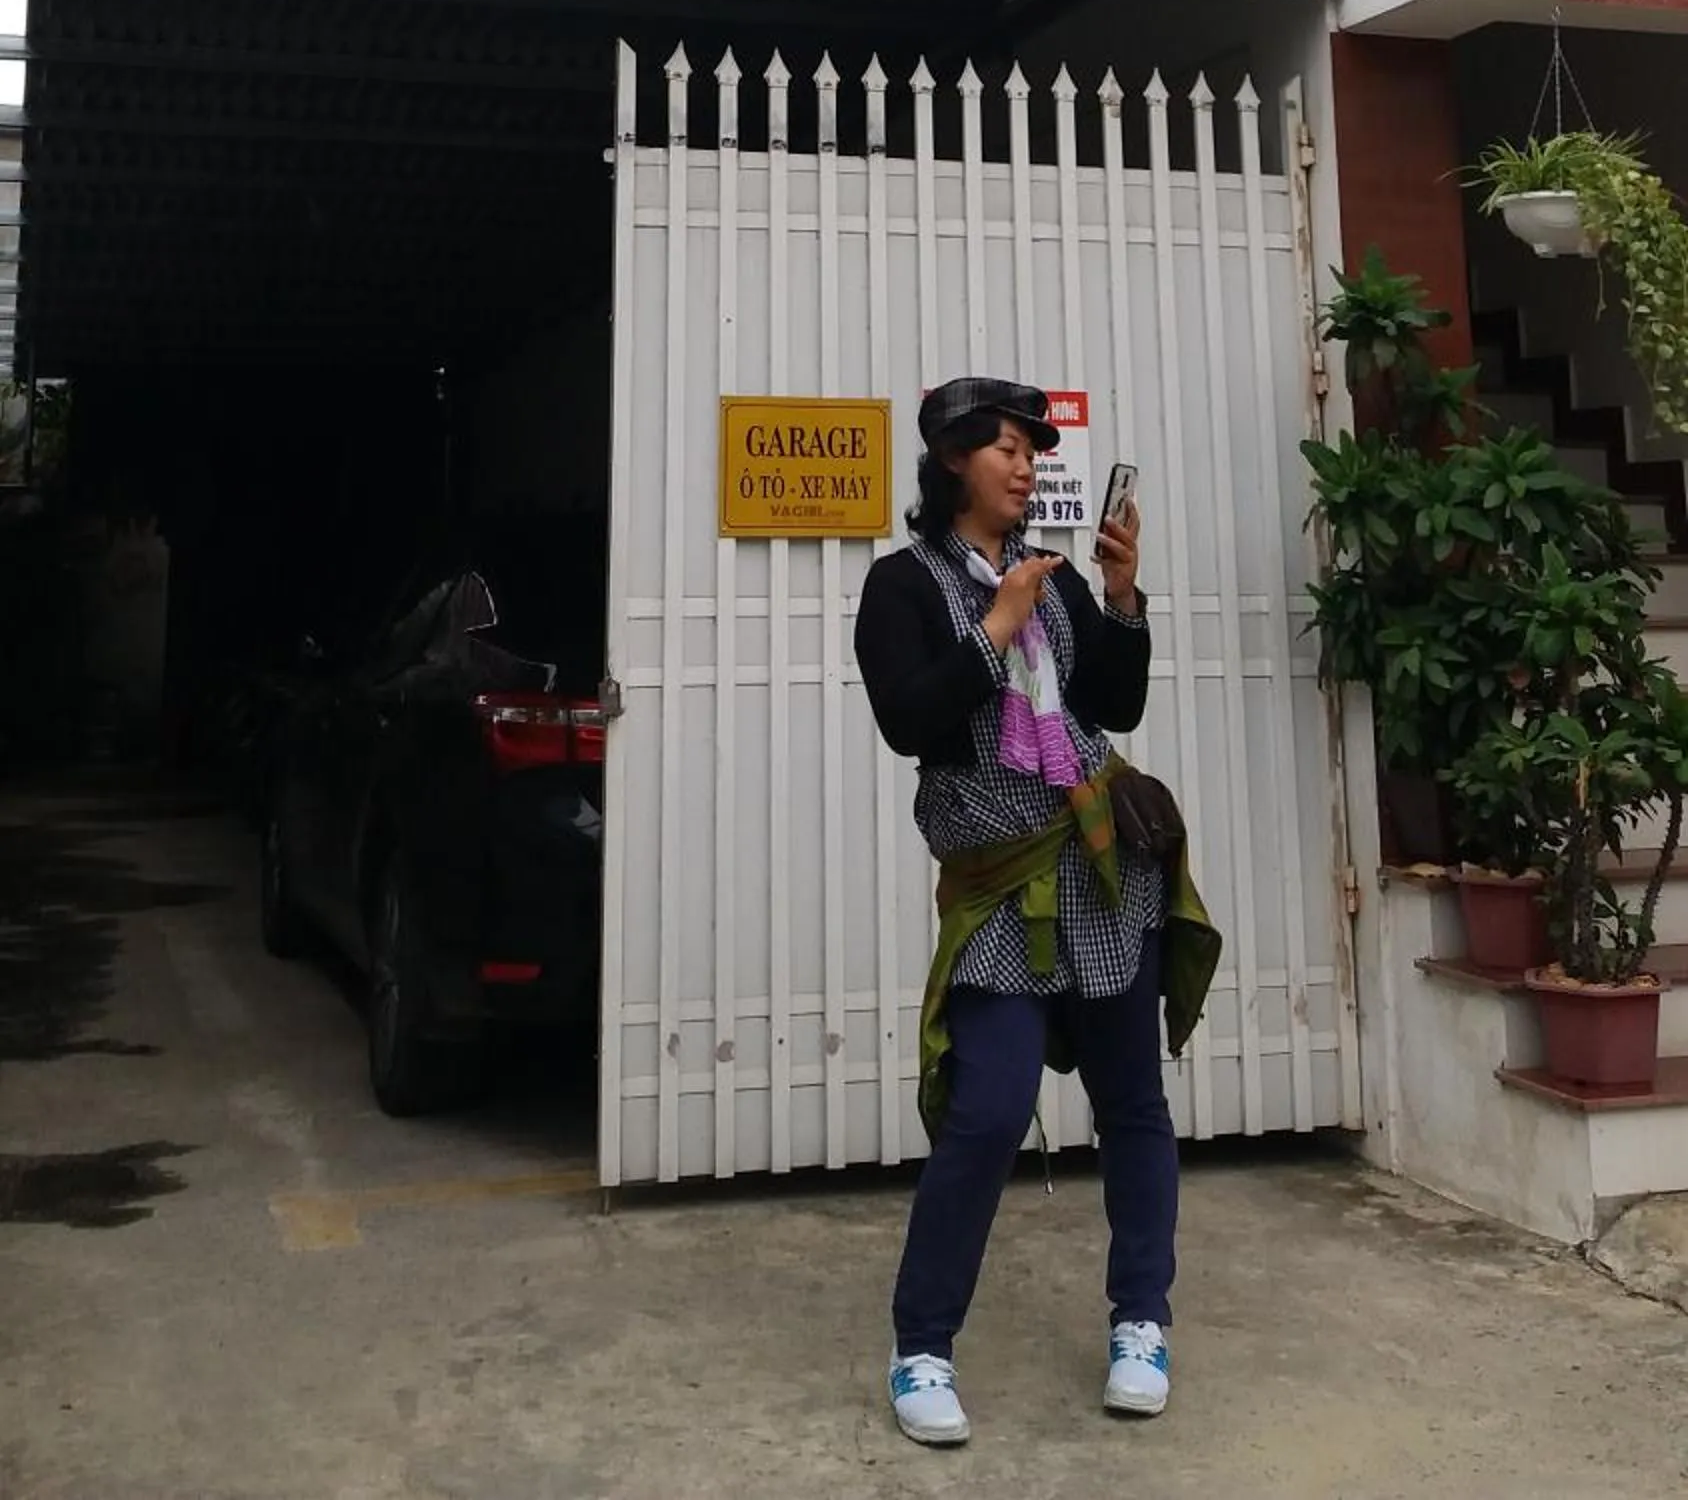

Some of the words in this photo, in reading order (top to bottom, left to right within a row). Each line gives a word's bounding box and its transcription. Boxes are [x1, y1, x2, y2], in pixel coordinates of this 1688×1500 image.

[745, 425, 867, 459] GARAGE
[739, 468, 754, 499] Ô
[800, 475, 825, 499] XE
[831, 468, 871, 500] MÁY
[1052, 500, 1083, 521] 976
